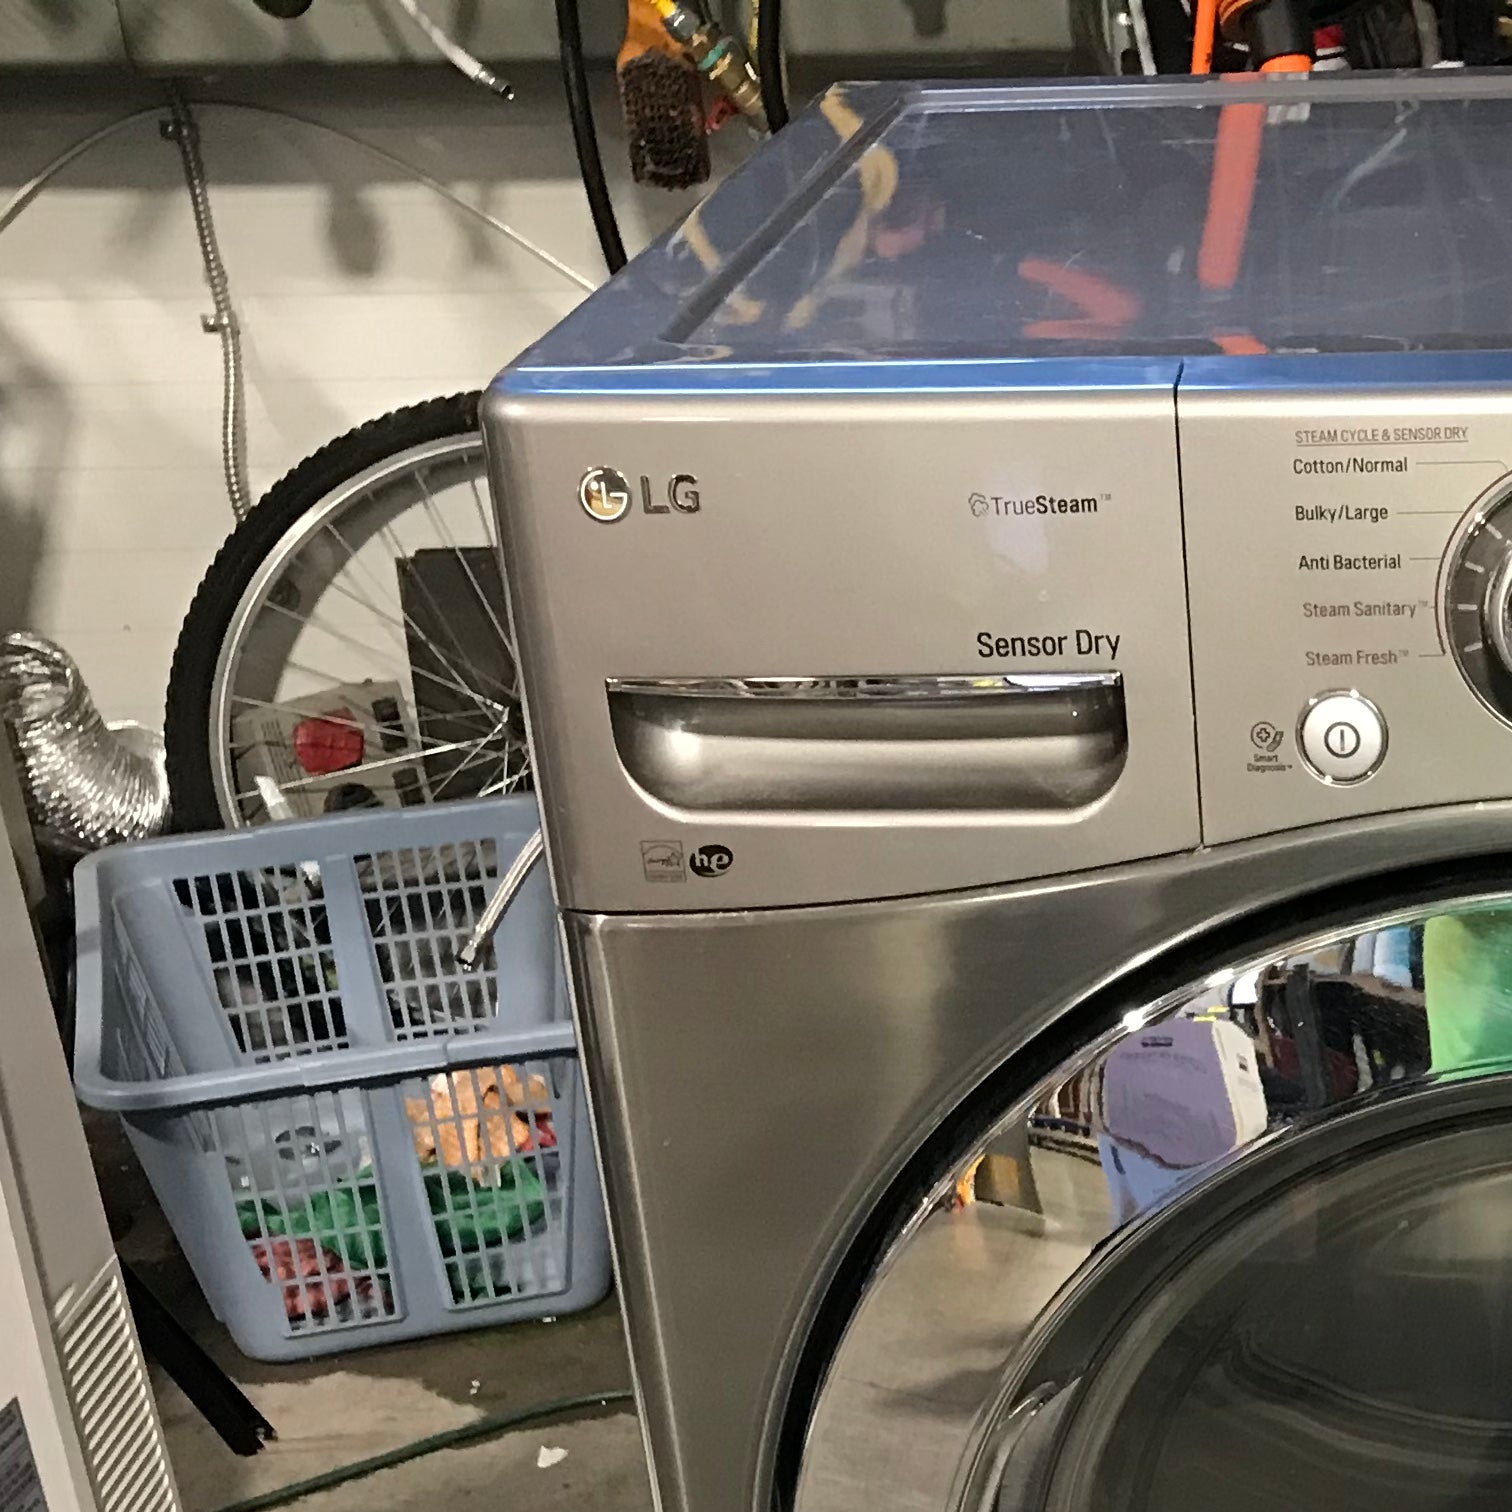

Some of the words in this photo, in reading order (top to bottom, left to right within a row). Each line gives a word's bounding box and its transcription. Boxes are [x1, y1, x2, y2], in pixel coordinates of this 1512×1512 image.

[1295, 429, 1338, 444] STEAM
[1340, 428, 1379, 443] CYCLE
[1381, 428, 1391, 442] &
[1393, 427, 1441, 441] SENSOR
[1444, 426, 1469, 440] DRY
[1293, 456, 1408, 475] Cotton/Normal
[640, 474, 700, 514] LG
[1295, 504, 1389, 524] Bulky/Large
[1298, 555, 1330, 570] Anti
[1333, 554, 1402, 570] Bacterial
[1303, 602, 1350, 618] Steam
[976, 631, 1068, 658] Sensor
[1075, 629, 1120, 661] Dry
[1305, 651, 1353, 666] Steam
[1254, 754, 1279, 763] Smart
[693, 847, 731, 876] he
